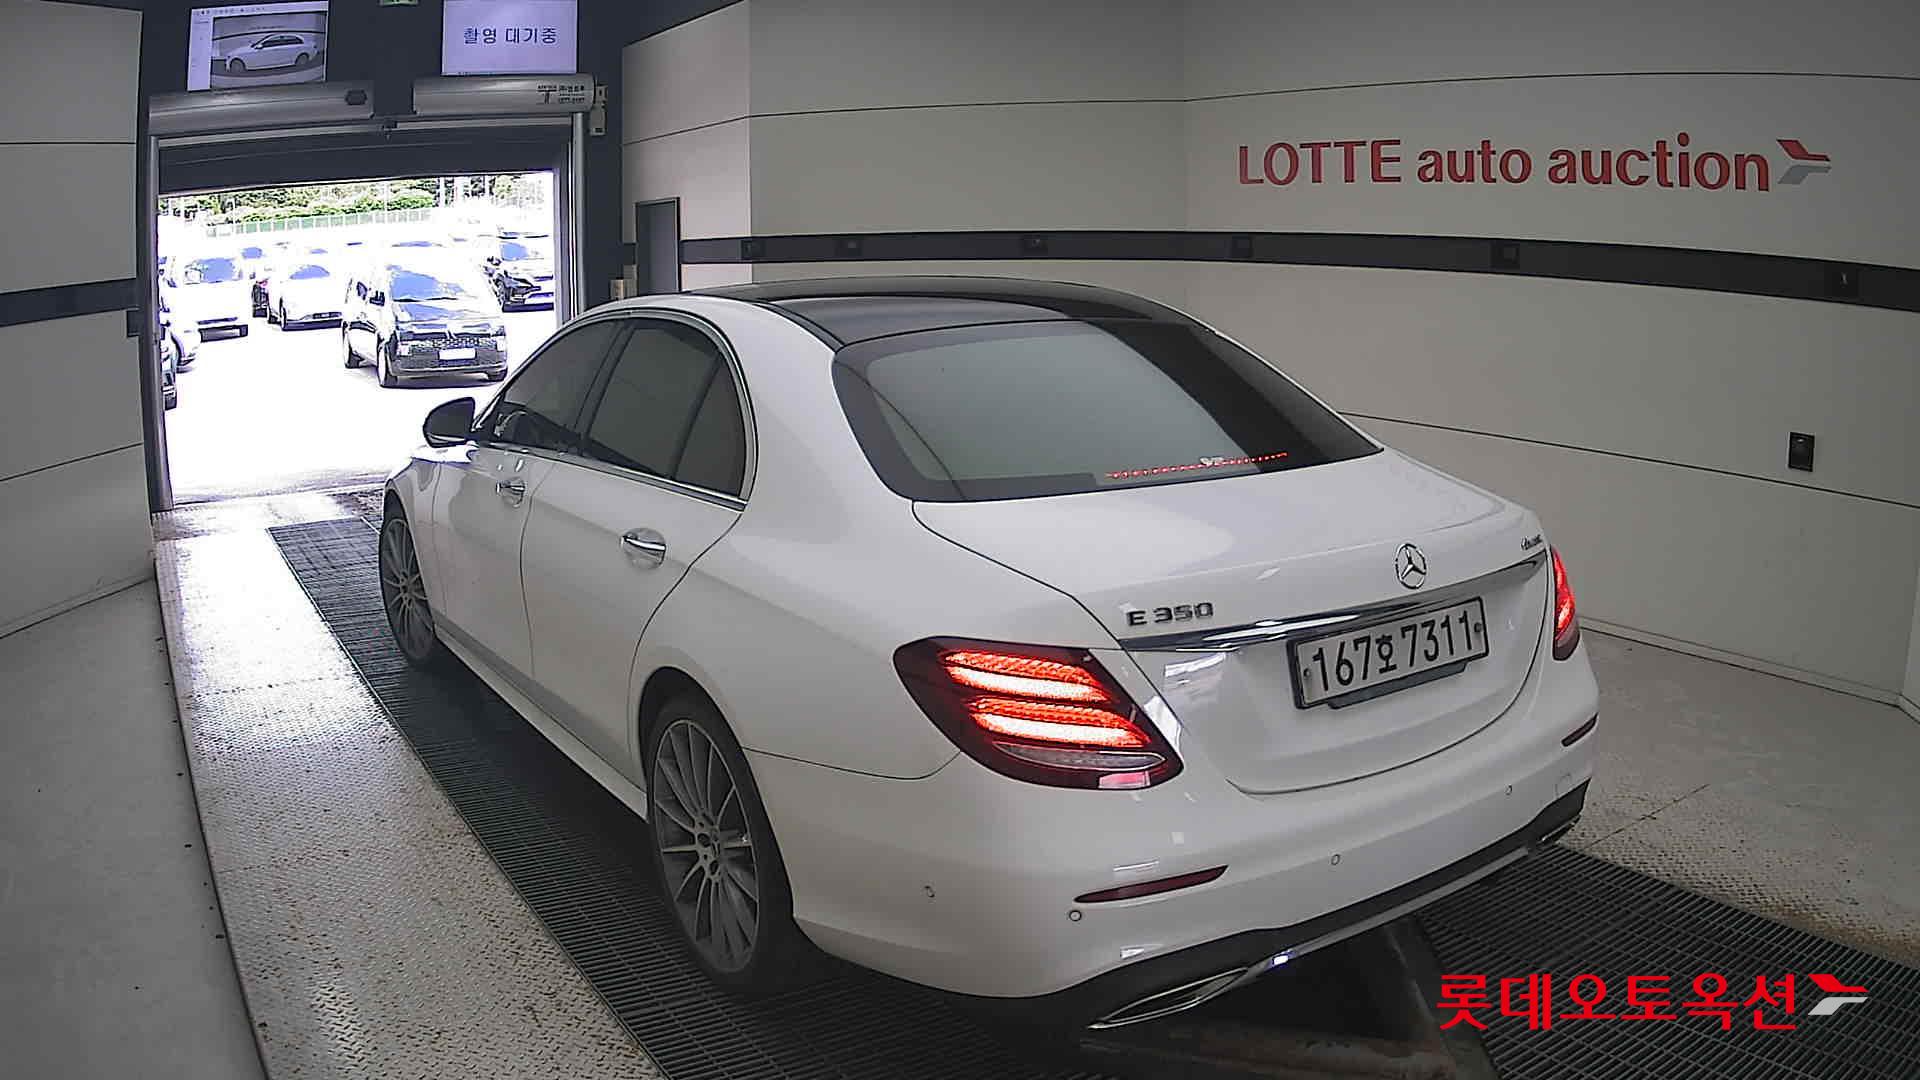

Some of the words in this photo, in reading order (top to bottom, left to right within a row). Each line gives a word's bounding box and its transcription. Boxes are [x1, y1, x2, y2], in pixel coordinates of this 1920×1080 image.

[463, 27, 497, 45] 촬영
[504, 27, 557, 44] 대기중
[1239, 139, 1401, 185] LOTTE
[1416, 140, 1532, 184] auto
[1548, 132, 1770, 192] auction
[1126, 610, 1148, 626] E
[1153, 602, 1214, 623] 350
